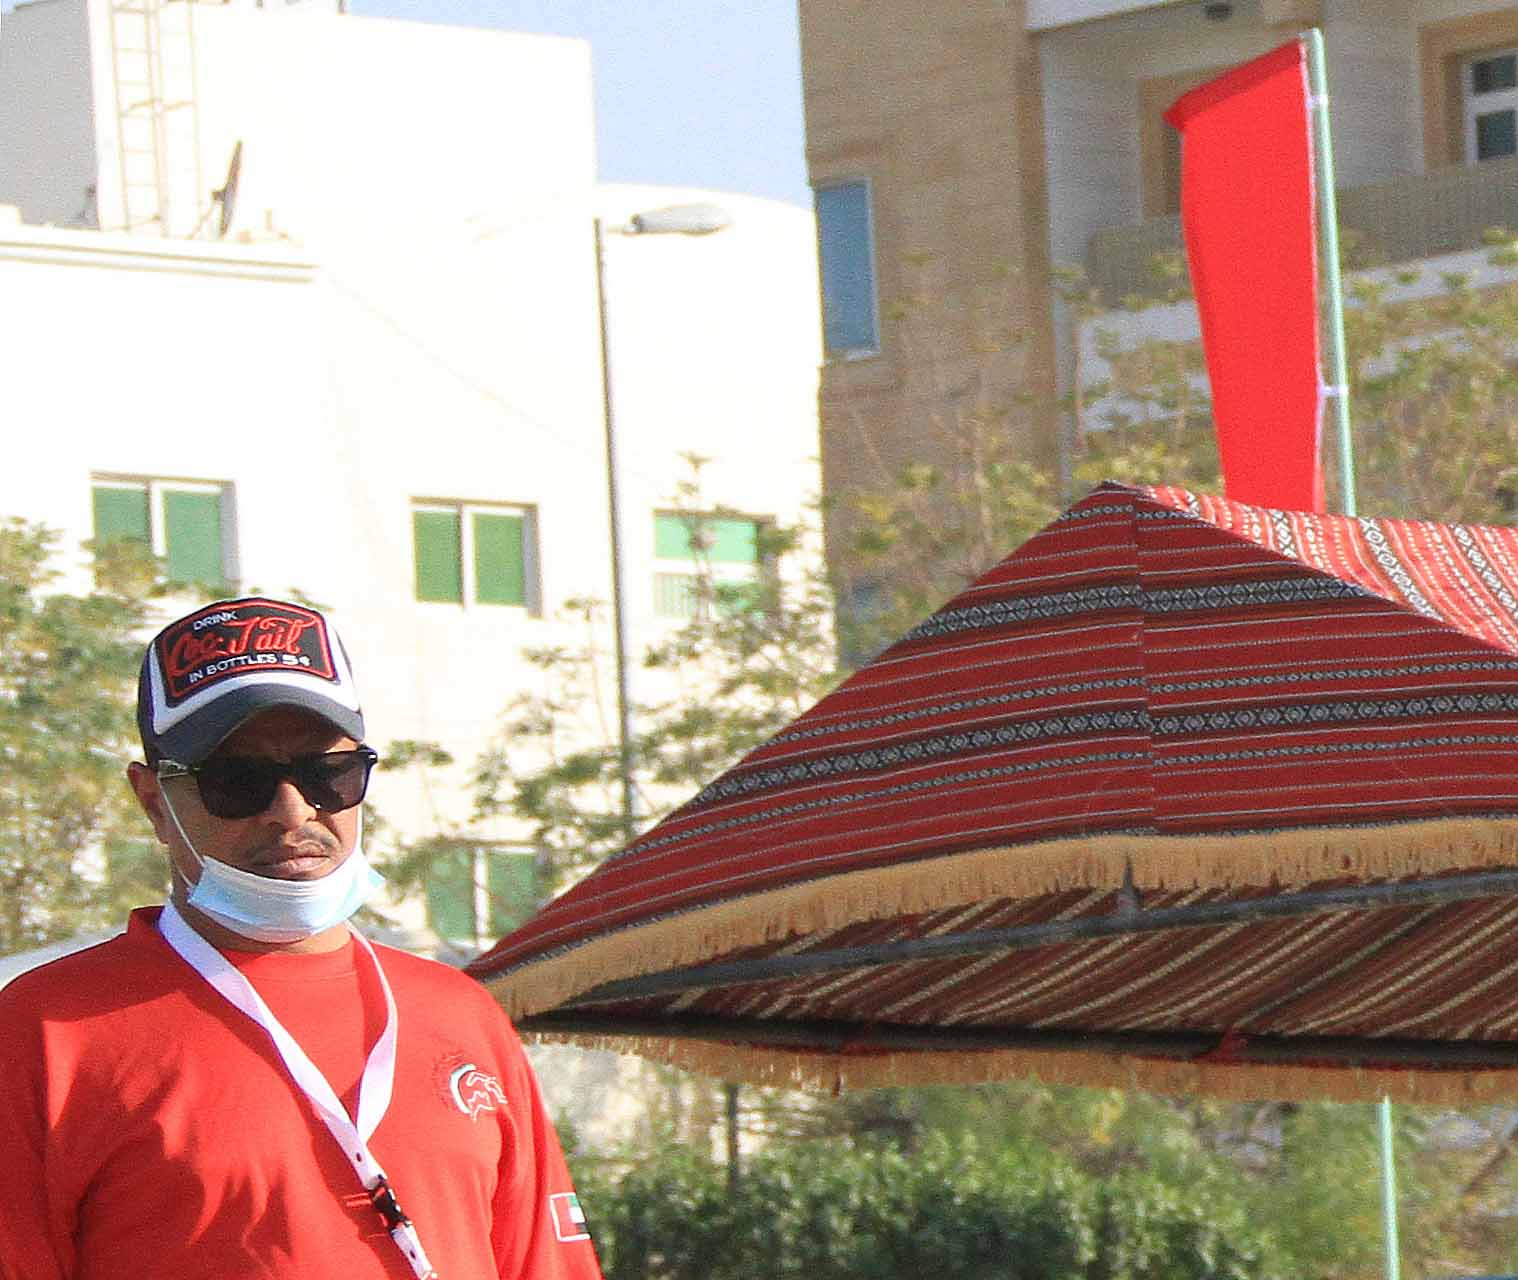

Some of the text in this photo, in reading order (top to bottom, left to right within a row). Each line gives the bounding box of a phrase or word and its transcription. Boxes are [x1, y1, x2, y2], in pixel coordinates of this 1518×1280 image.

[193, 611, 238, 630] DRINK
[189, 669, 204, 683] IN
[206, 652, 277, 676] BOTTLES
